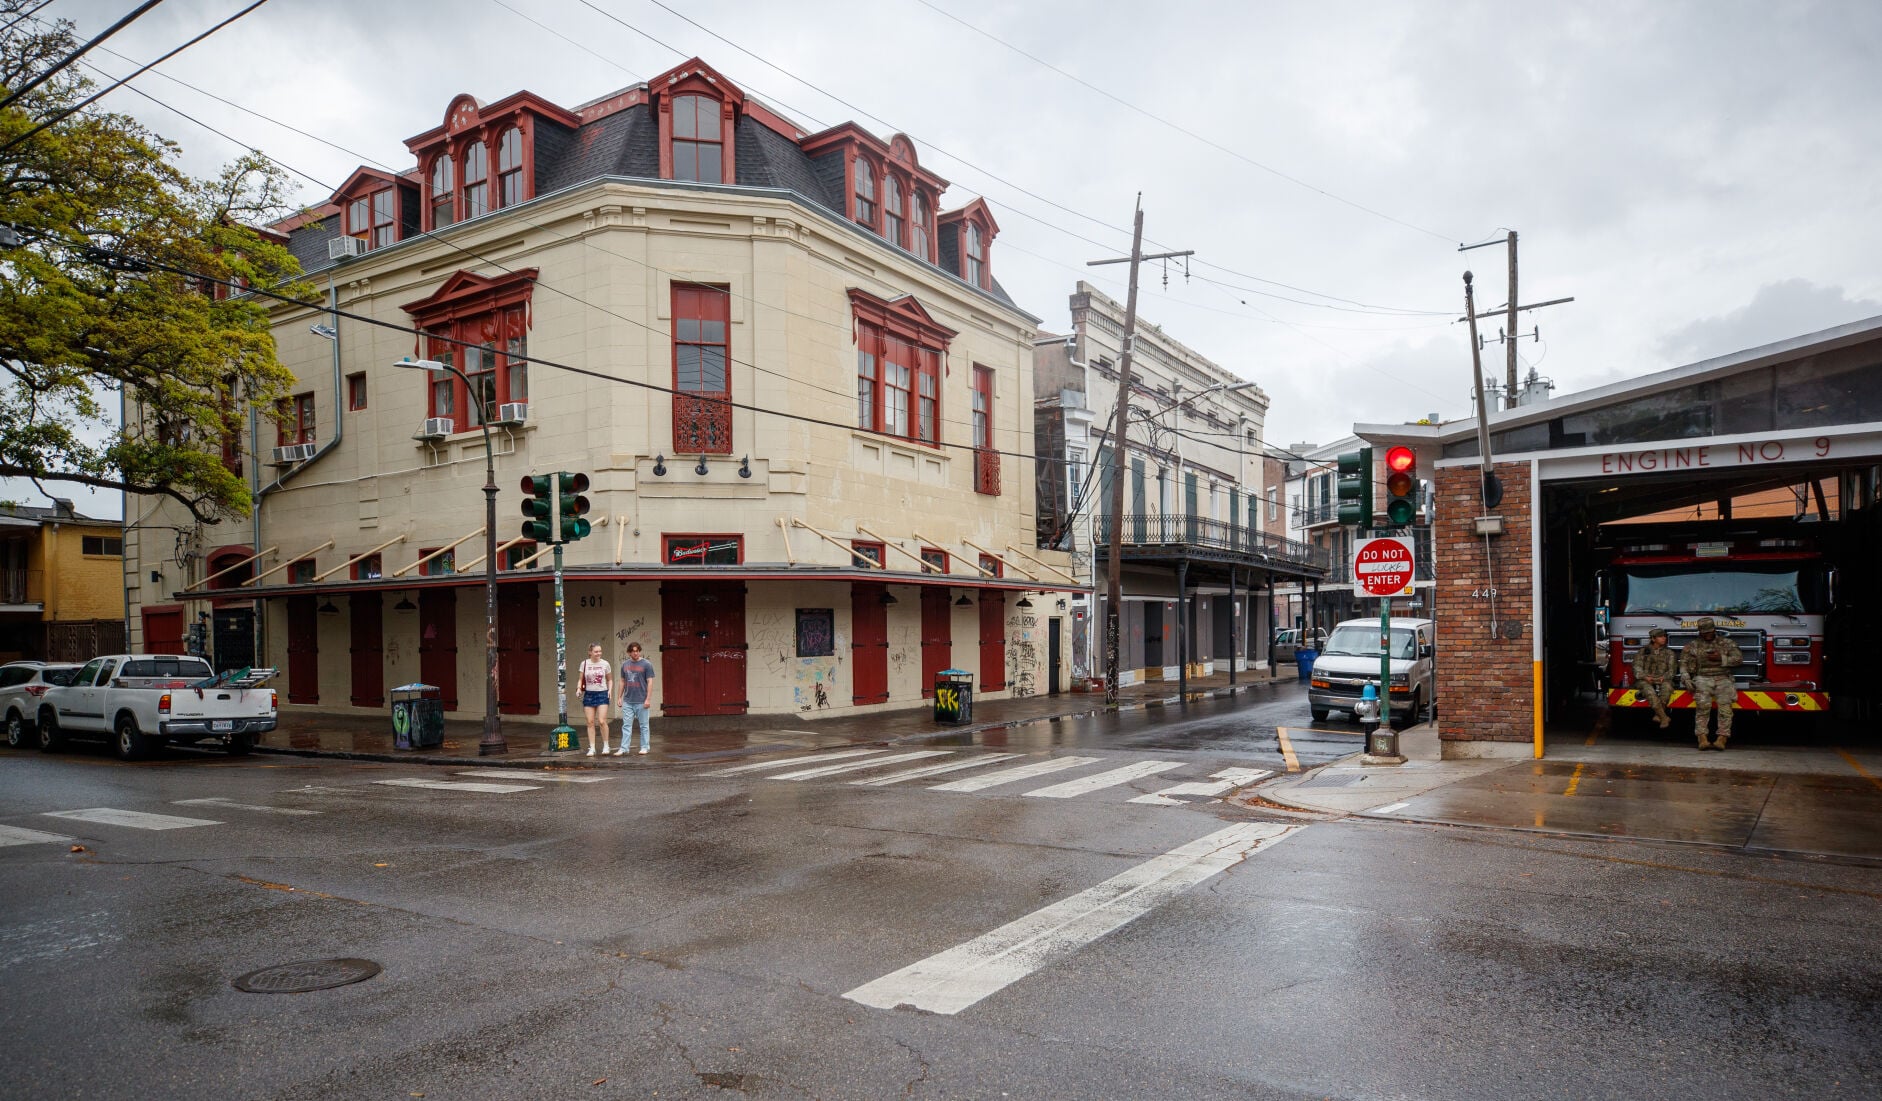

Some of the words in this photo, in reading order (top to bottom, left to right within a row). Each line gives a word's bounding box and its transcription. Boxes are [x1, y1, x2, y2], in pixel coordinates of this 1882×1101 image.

[1602, 446, 1710, 473] ENGINE
[1738, 441, 1785, 463] NO.
[1815, 437, 1830, 457] 9
[1363, 550, 1378, 560] DO
[1382, 549, 1404, 559] NOT
[1367, 575, 1401, 585] ENTER
[1472, 588, 1497, 599] 449
[580, 595, 603, 608] 501
